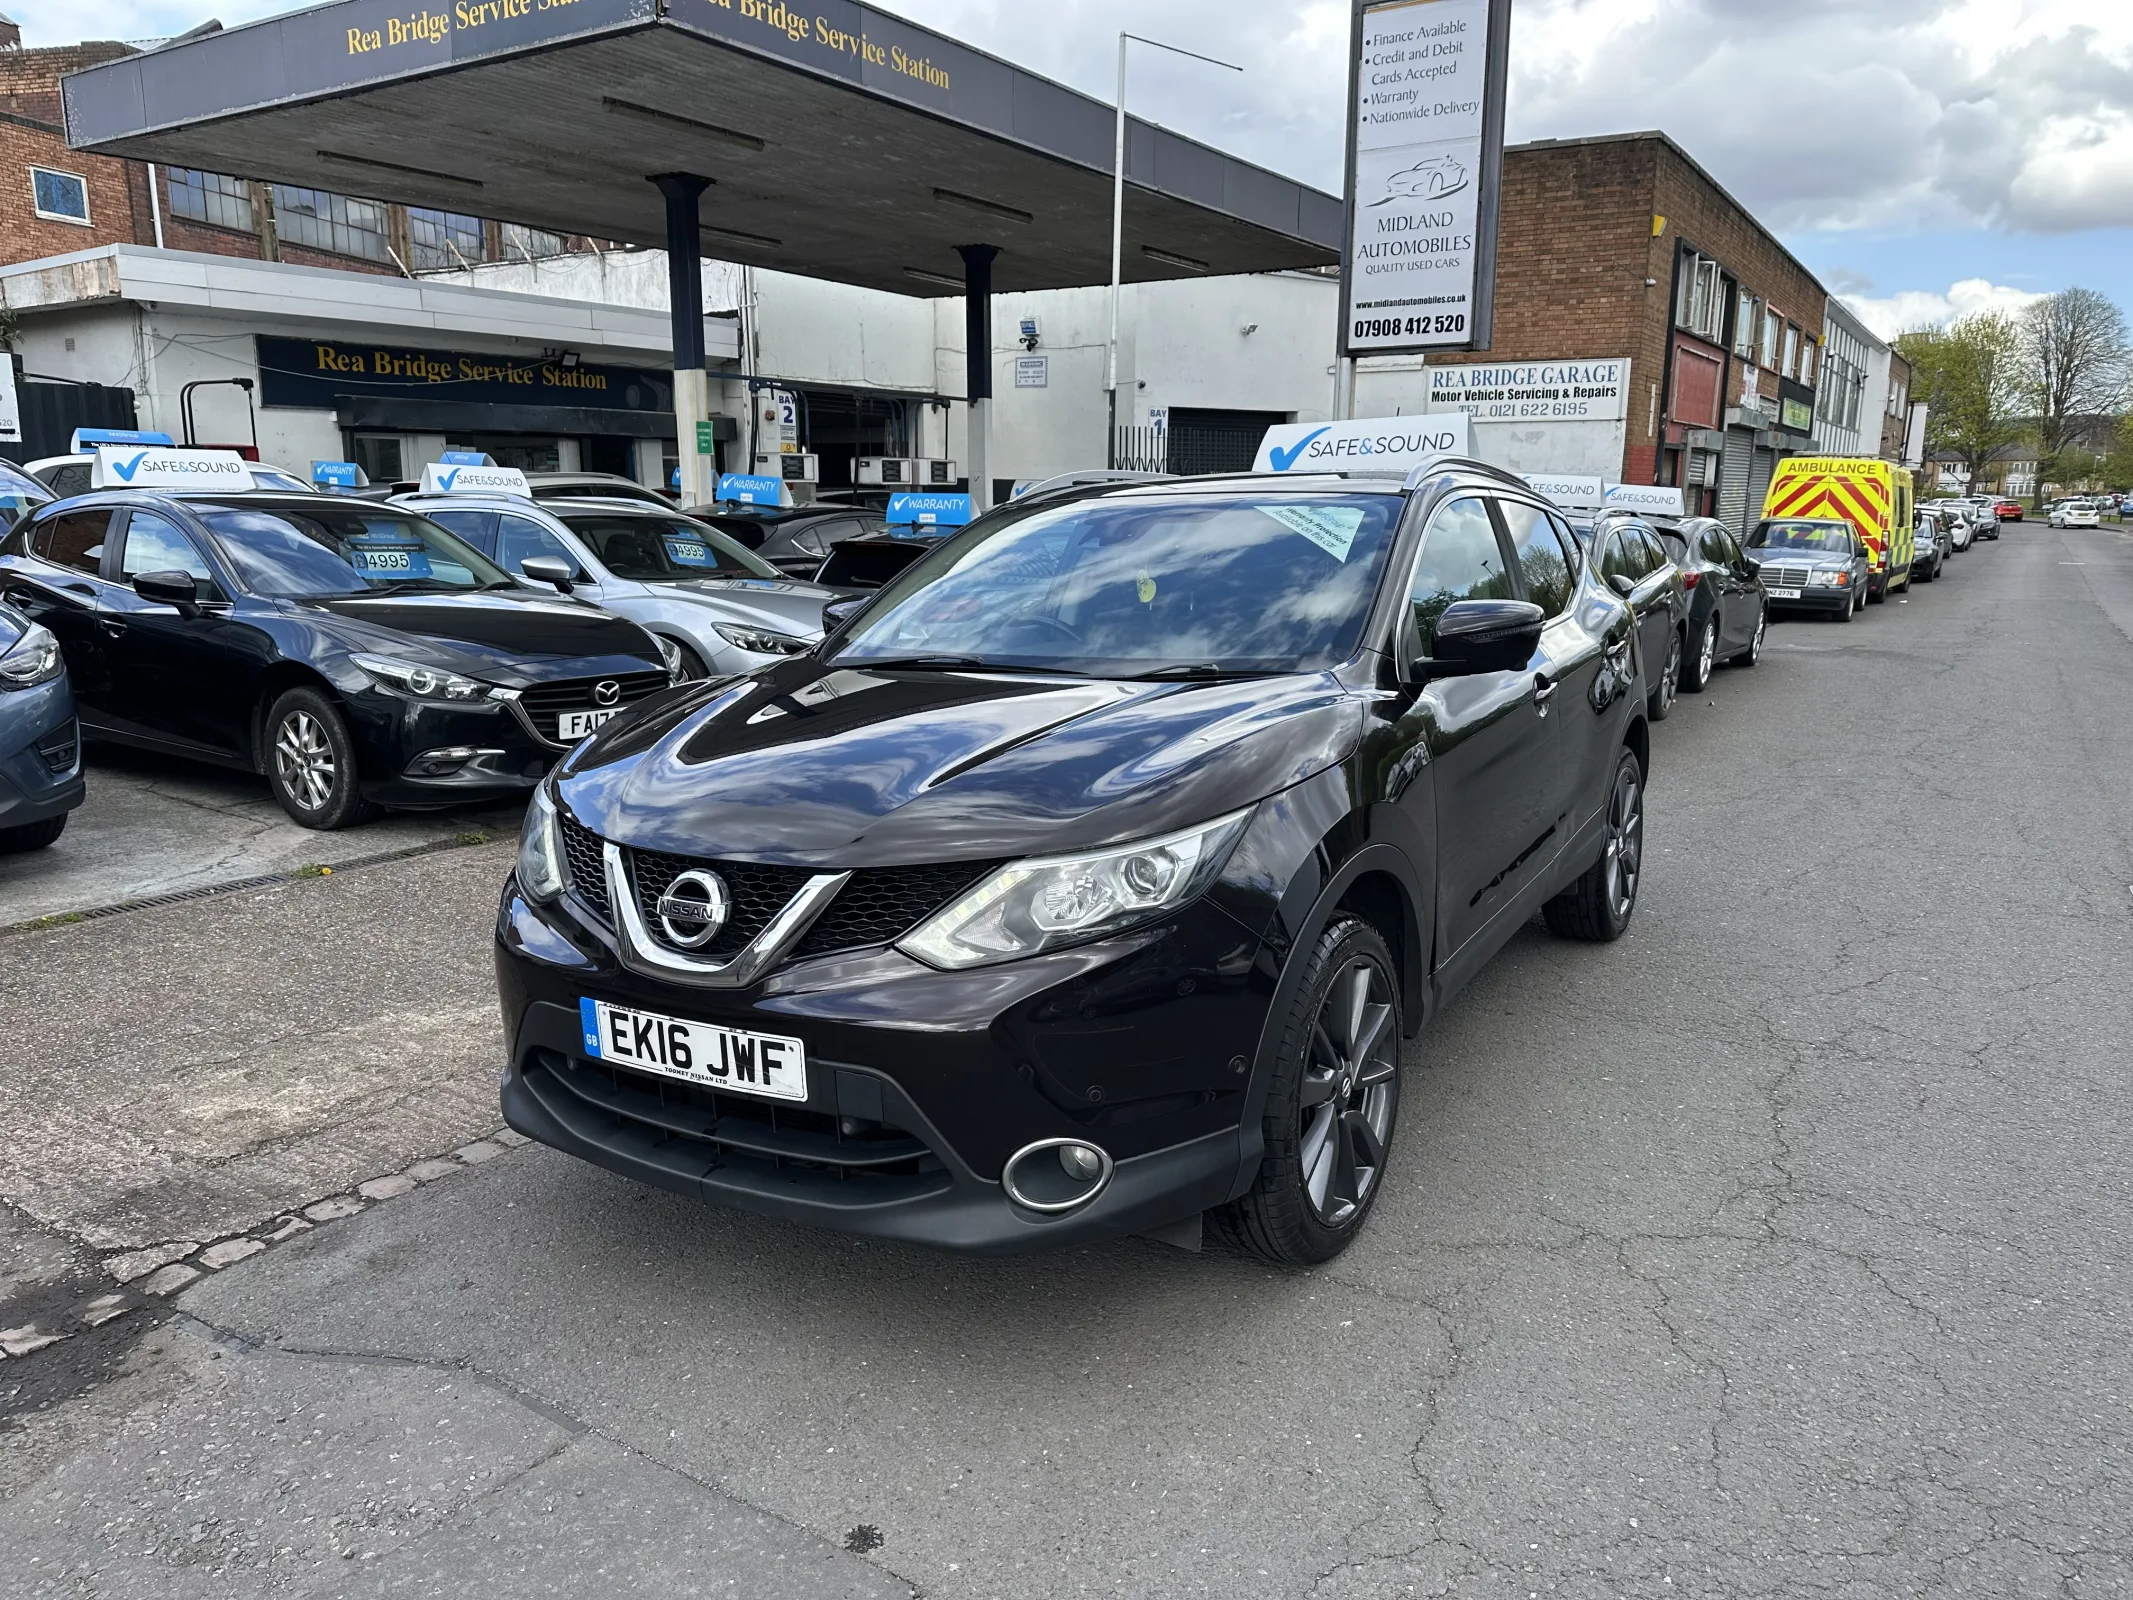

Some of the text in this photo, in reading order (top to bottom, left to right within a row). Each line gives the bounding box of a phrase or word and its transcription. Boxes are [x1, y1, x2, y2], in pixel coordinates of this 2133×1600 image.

[347, 0, 531, 54] Rea Bridge Service
[1374, 20, 1466, 46] Finance Available
[740, 0, 950, 89] Bridge Service Station
[1372, 41, 1463, 66] Credit and Debit
[1372, 61, 1456, 86] Cards Accepted
[1370, 88, 1419, 105] Warranty
[1370, 100, 1480, 124] Nationwide Delivery
[1378, 212, 1454, 232] MIDLAND
[1358, 235, 1472, 259] AUTOMOBILES
[1366, 258, 1460, 274] QUALITY USED CARS
[1356, 294, 1466, 309] www.midlandautomobiles.co.uk
[1354, 314, 1464, 338] 07908 412 520
[316, 346, 606, 390] Rea Bridge Service Station
[1433, 364, 1618, 388] REA BRIDGE GARAGE
[778, 396, 795, 404] BAY
[1432, 386, 1616, 402] Motor Vehicle Servicing & Repairs
[784, 406, 793, 424] 2
[1150, 410, 1167, 418] BAY
[1458, 402, 1588, 418] TEL. 0121 622 6195
[1154, 418, 1162, 436] 1
[1308, 432, 1454, 458] SAFE&SOUND
[142, 460, 240, 473] SAFE&SOUND
[325, 466, 354, 475] WARRANTY
[1788, 462, 1876, 474] AMBULANCE
[456, 474, 522, 486] SAFE&SOUND
[733, 479, 776, 492] WARRANTY
[1530, 484, 1594, 495] FE&SOUND
[1611, 492, 1676, 504] SAFE&SOUND
[908, 498, 966, 510] WARRANTY
[1273, 510, 1303, 530] Available
[1312, 531, 1324, 541] this
[1323, 540, 1336, 548] car
[1286, 507, 1347, 544] Warranty Protection
[661, 900, 713, 920] NISSAN
[586, 1034, 598, 1046] GB
[608, 1010, 786, 1086] EK16 JWF
[690, 1072, 714, 1082] NISSAN
